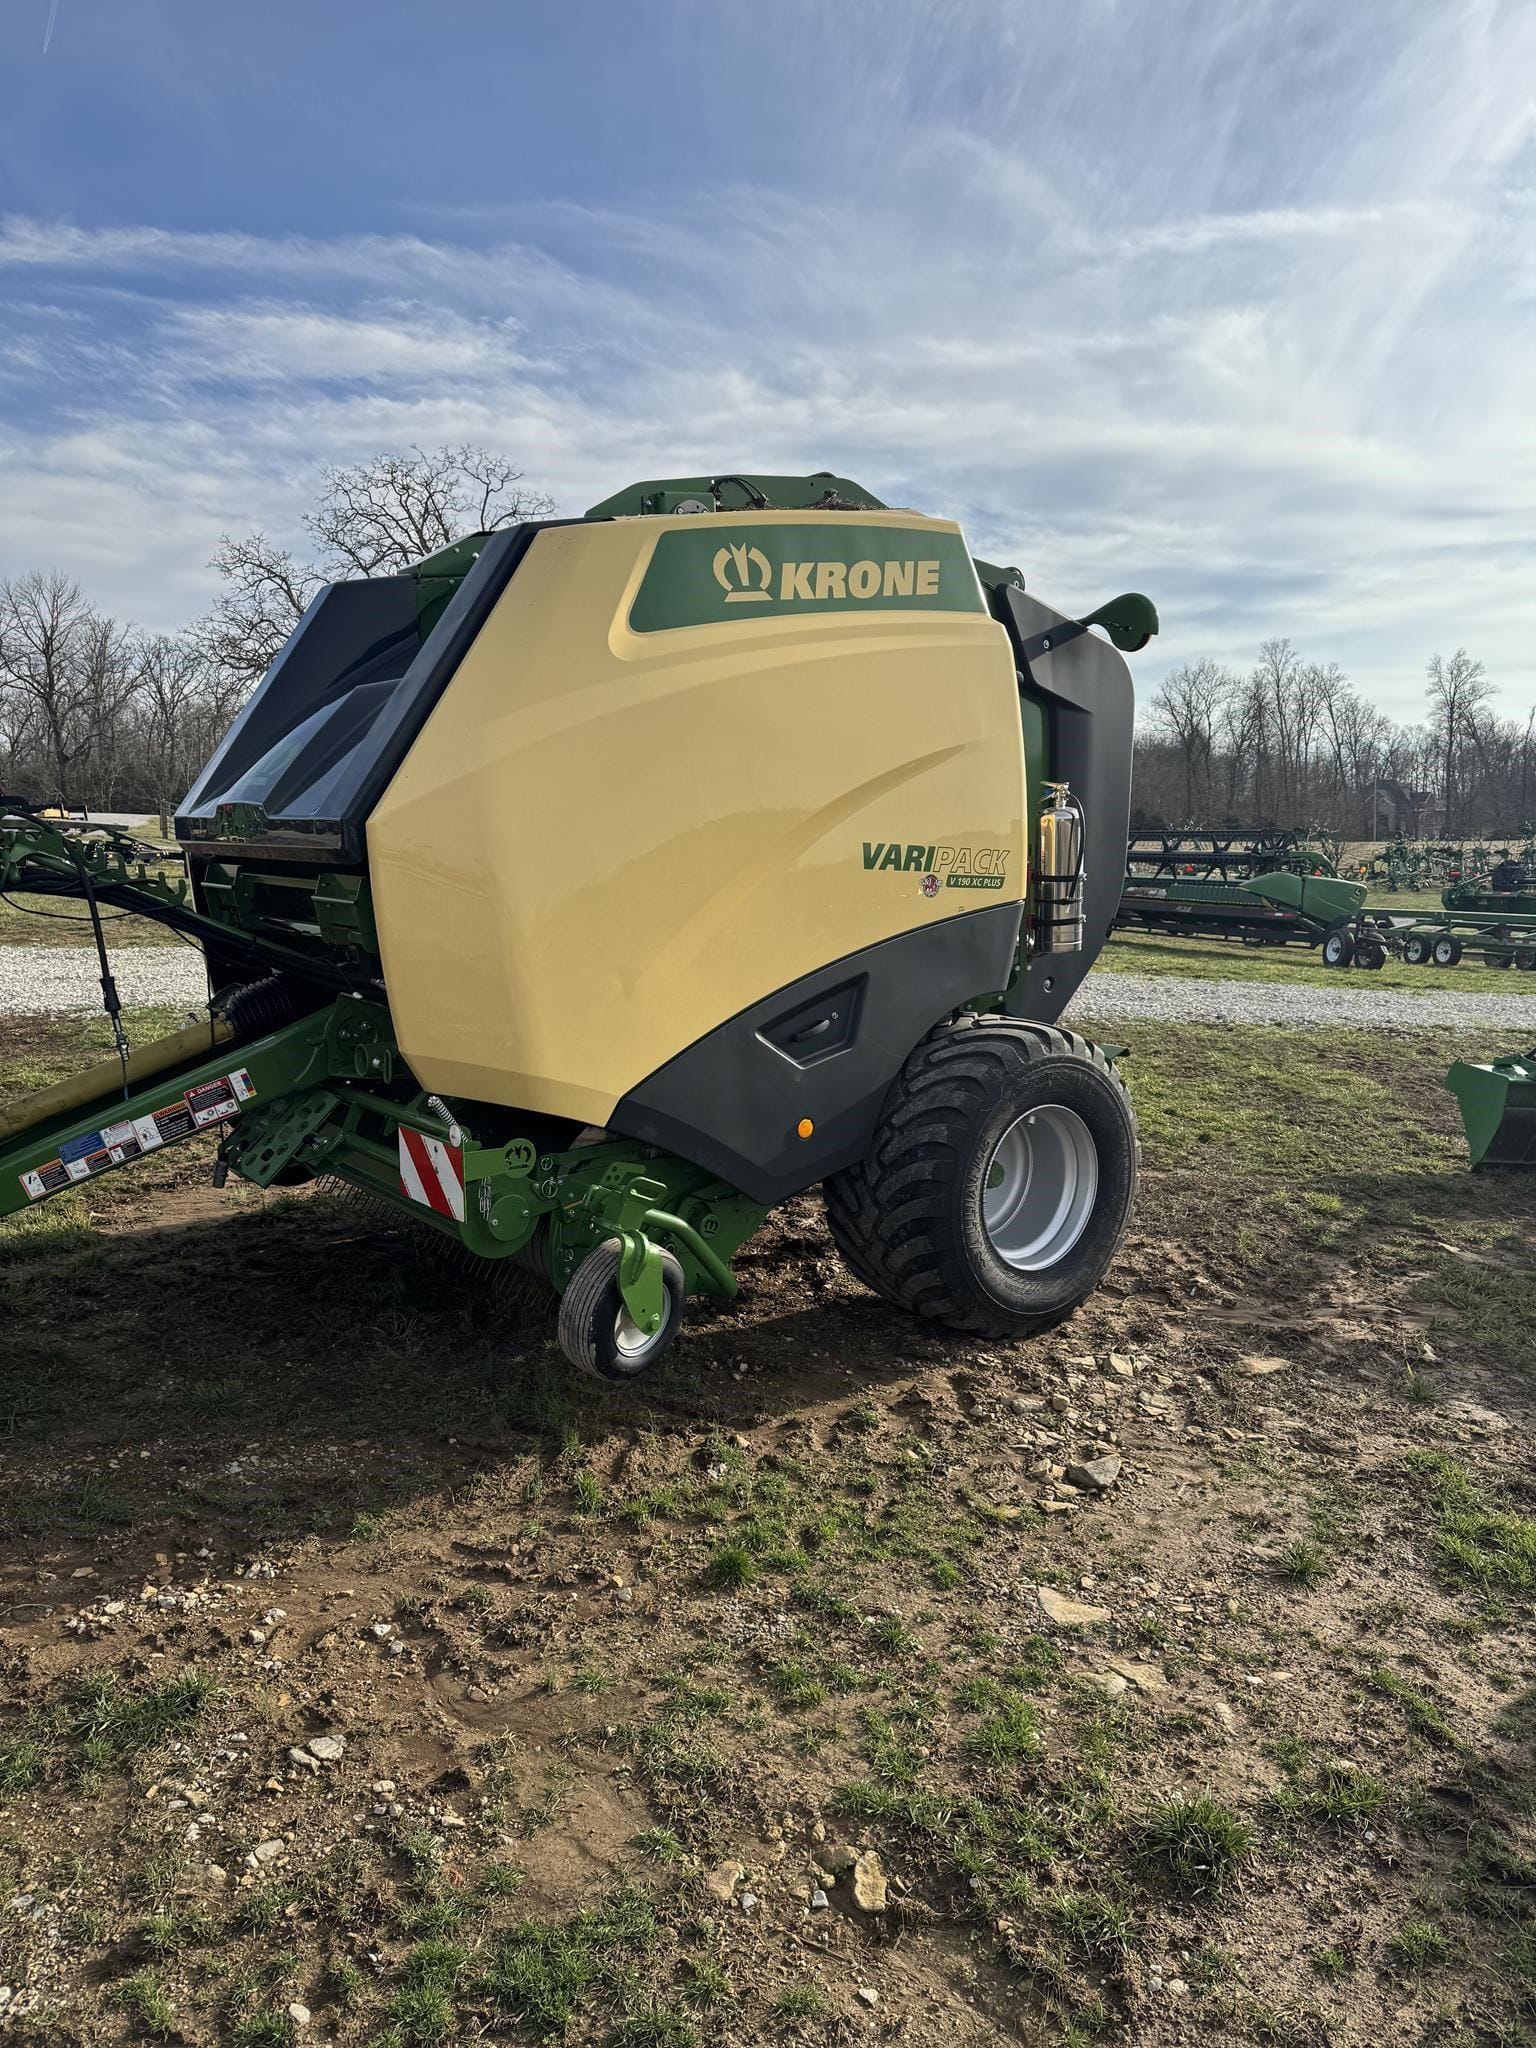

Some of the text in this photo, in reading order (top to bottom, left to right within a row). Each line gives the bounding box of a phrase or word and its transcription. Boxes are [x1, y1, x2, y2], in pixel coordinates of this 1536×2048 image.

[780, 560, 940, 600] KRONE
[863, 842, 1011, 876] VARIPACK
[950, 877, 956, 886] V
[958, 877, 971, 886] 190
[971, 878, 983, 887] XC
[983, 878, 1001, 888] PLUS
[197, 1080, 222, 1094] DANGER
